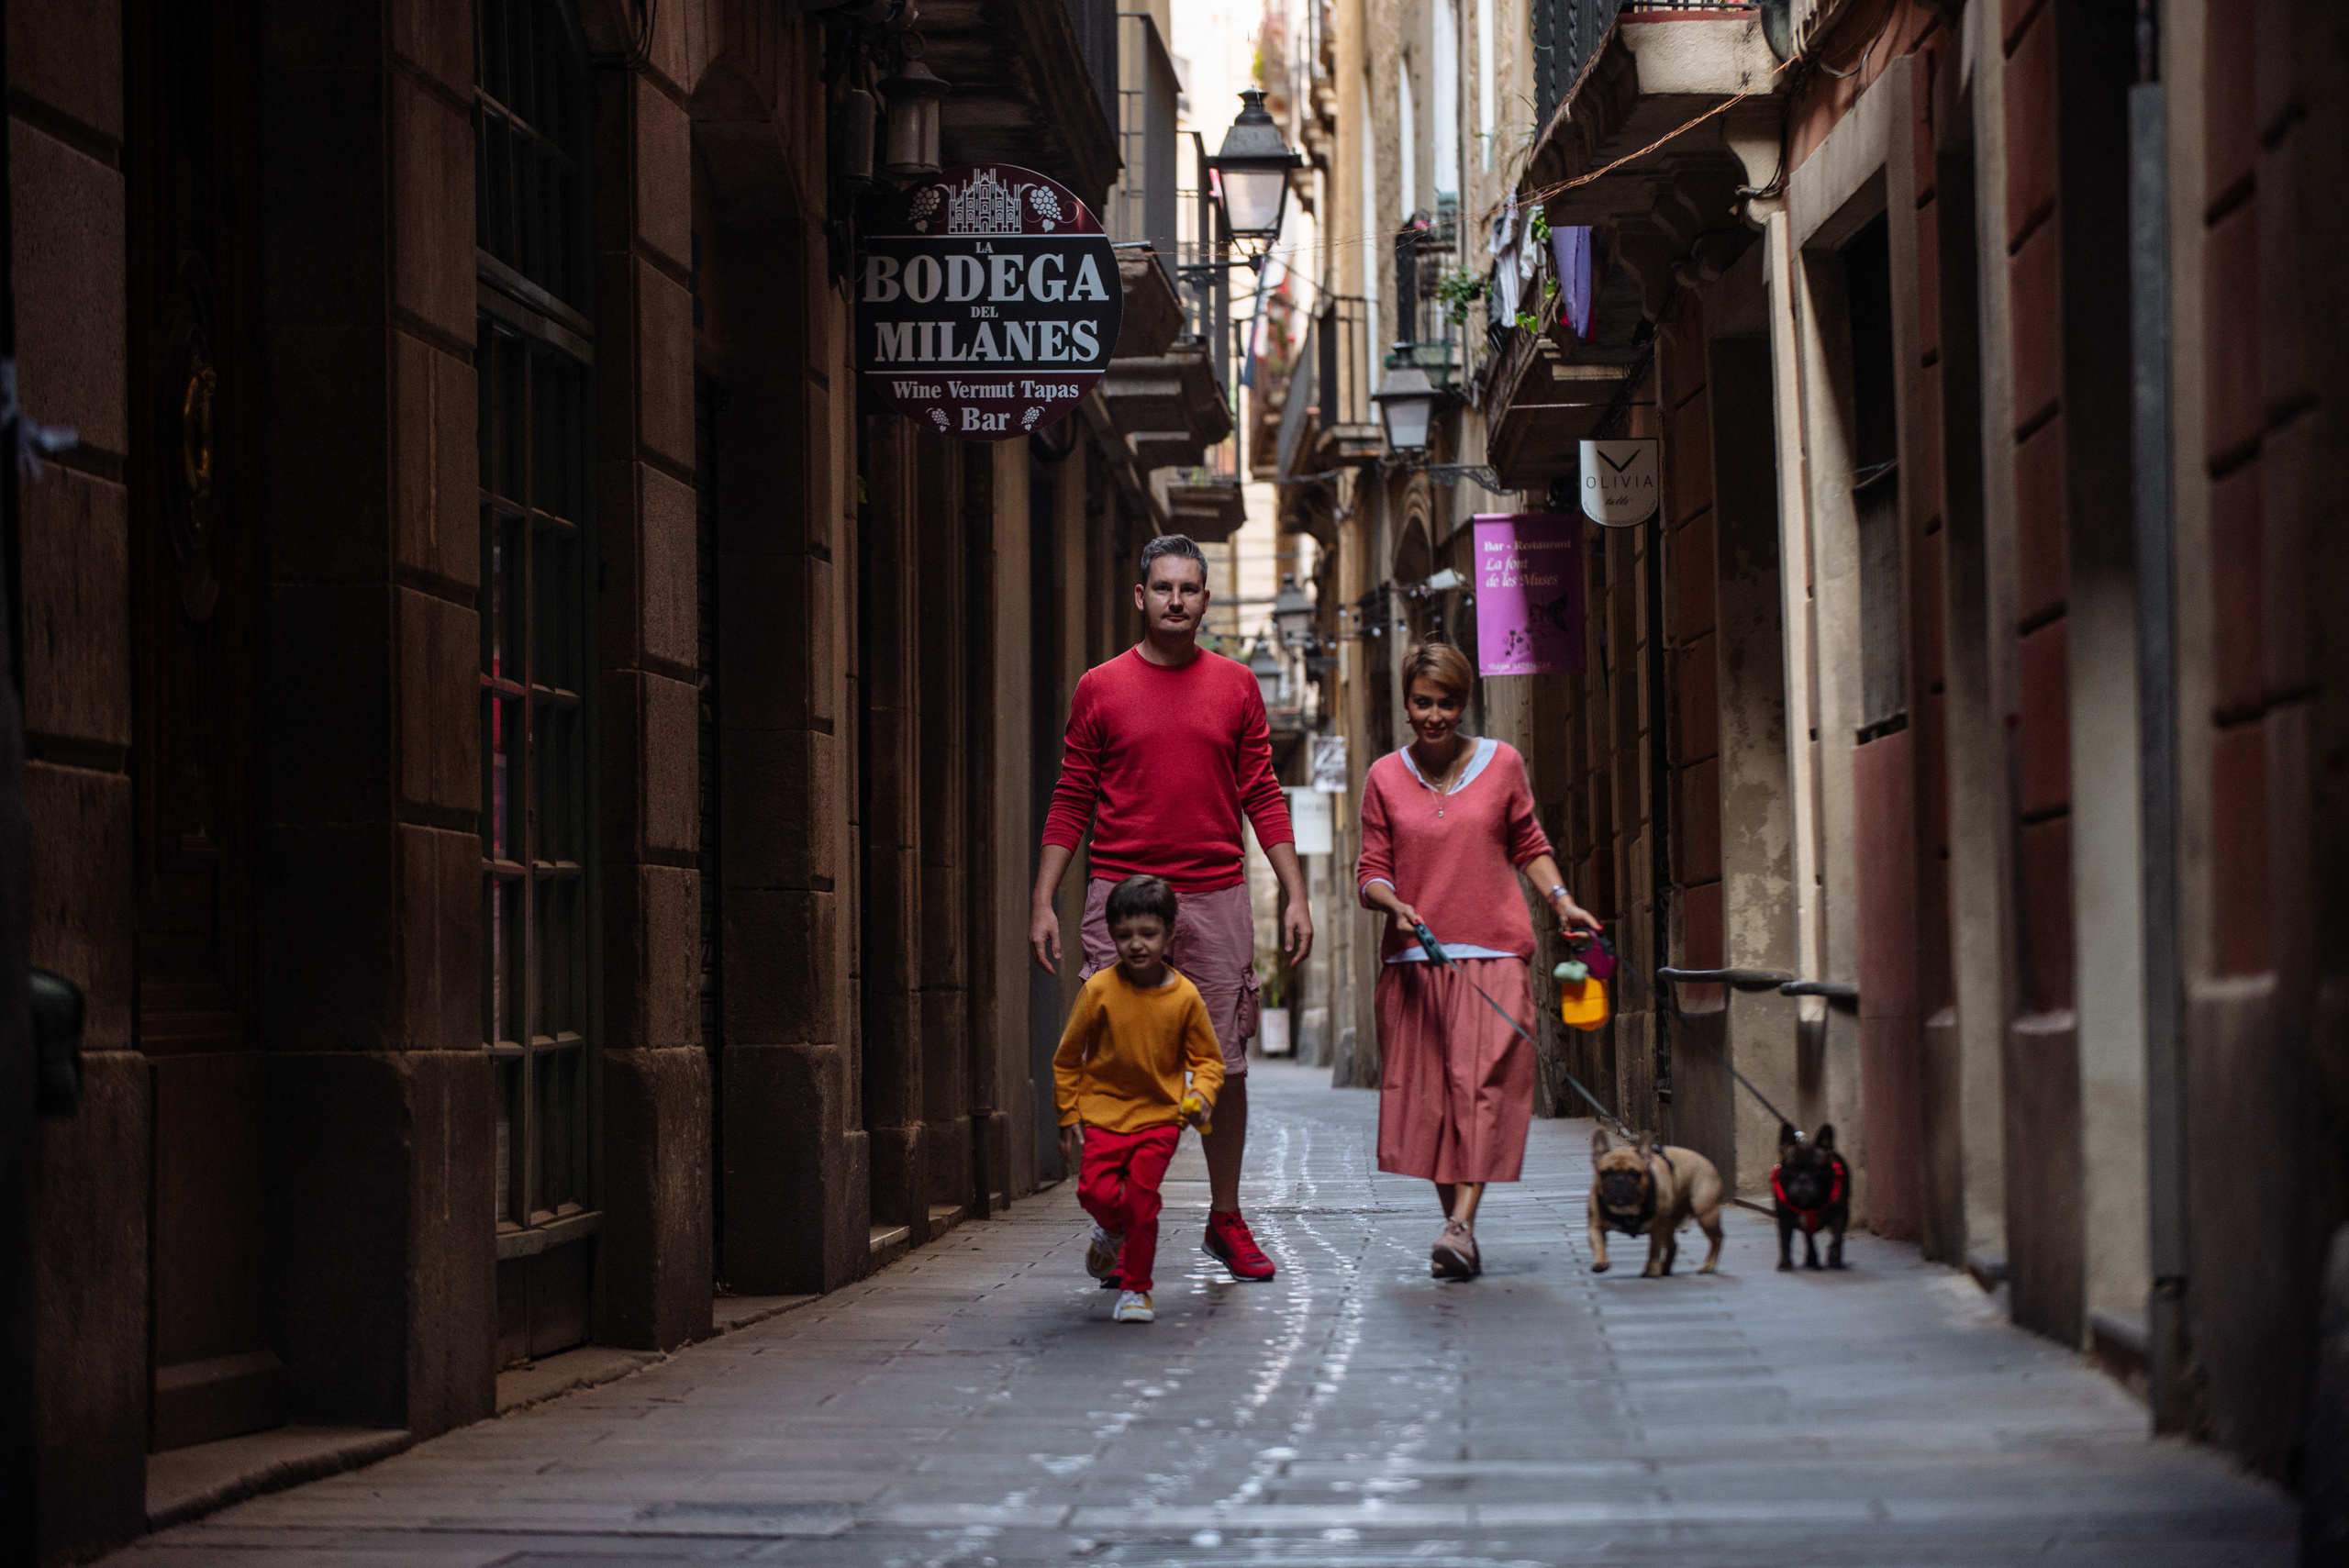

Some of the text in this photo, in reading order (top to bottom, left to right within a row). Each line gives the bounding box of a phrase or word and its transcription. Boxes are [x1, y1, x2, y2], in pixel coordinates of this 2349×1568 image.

[975, 241, 994, 253] LA
[863, 252, 1109, 303] BODEGA
[971, 306, 998, 318] DEL
[874, 319, 1100, 362] MILANES
[892, 380, 1079, 402] Wine Vermut Tapas
[961, 407, 1011, 431] Bar
[1586, 475, 1653, 489] OLIVIA
[1484, 541, 1504, 552] Bar
[1485, 557, 1502, 571] La
[1486, 573, 1499, 588] de
[1520, 573, 1558, 587] Muses
